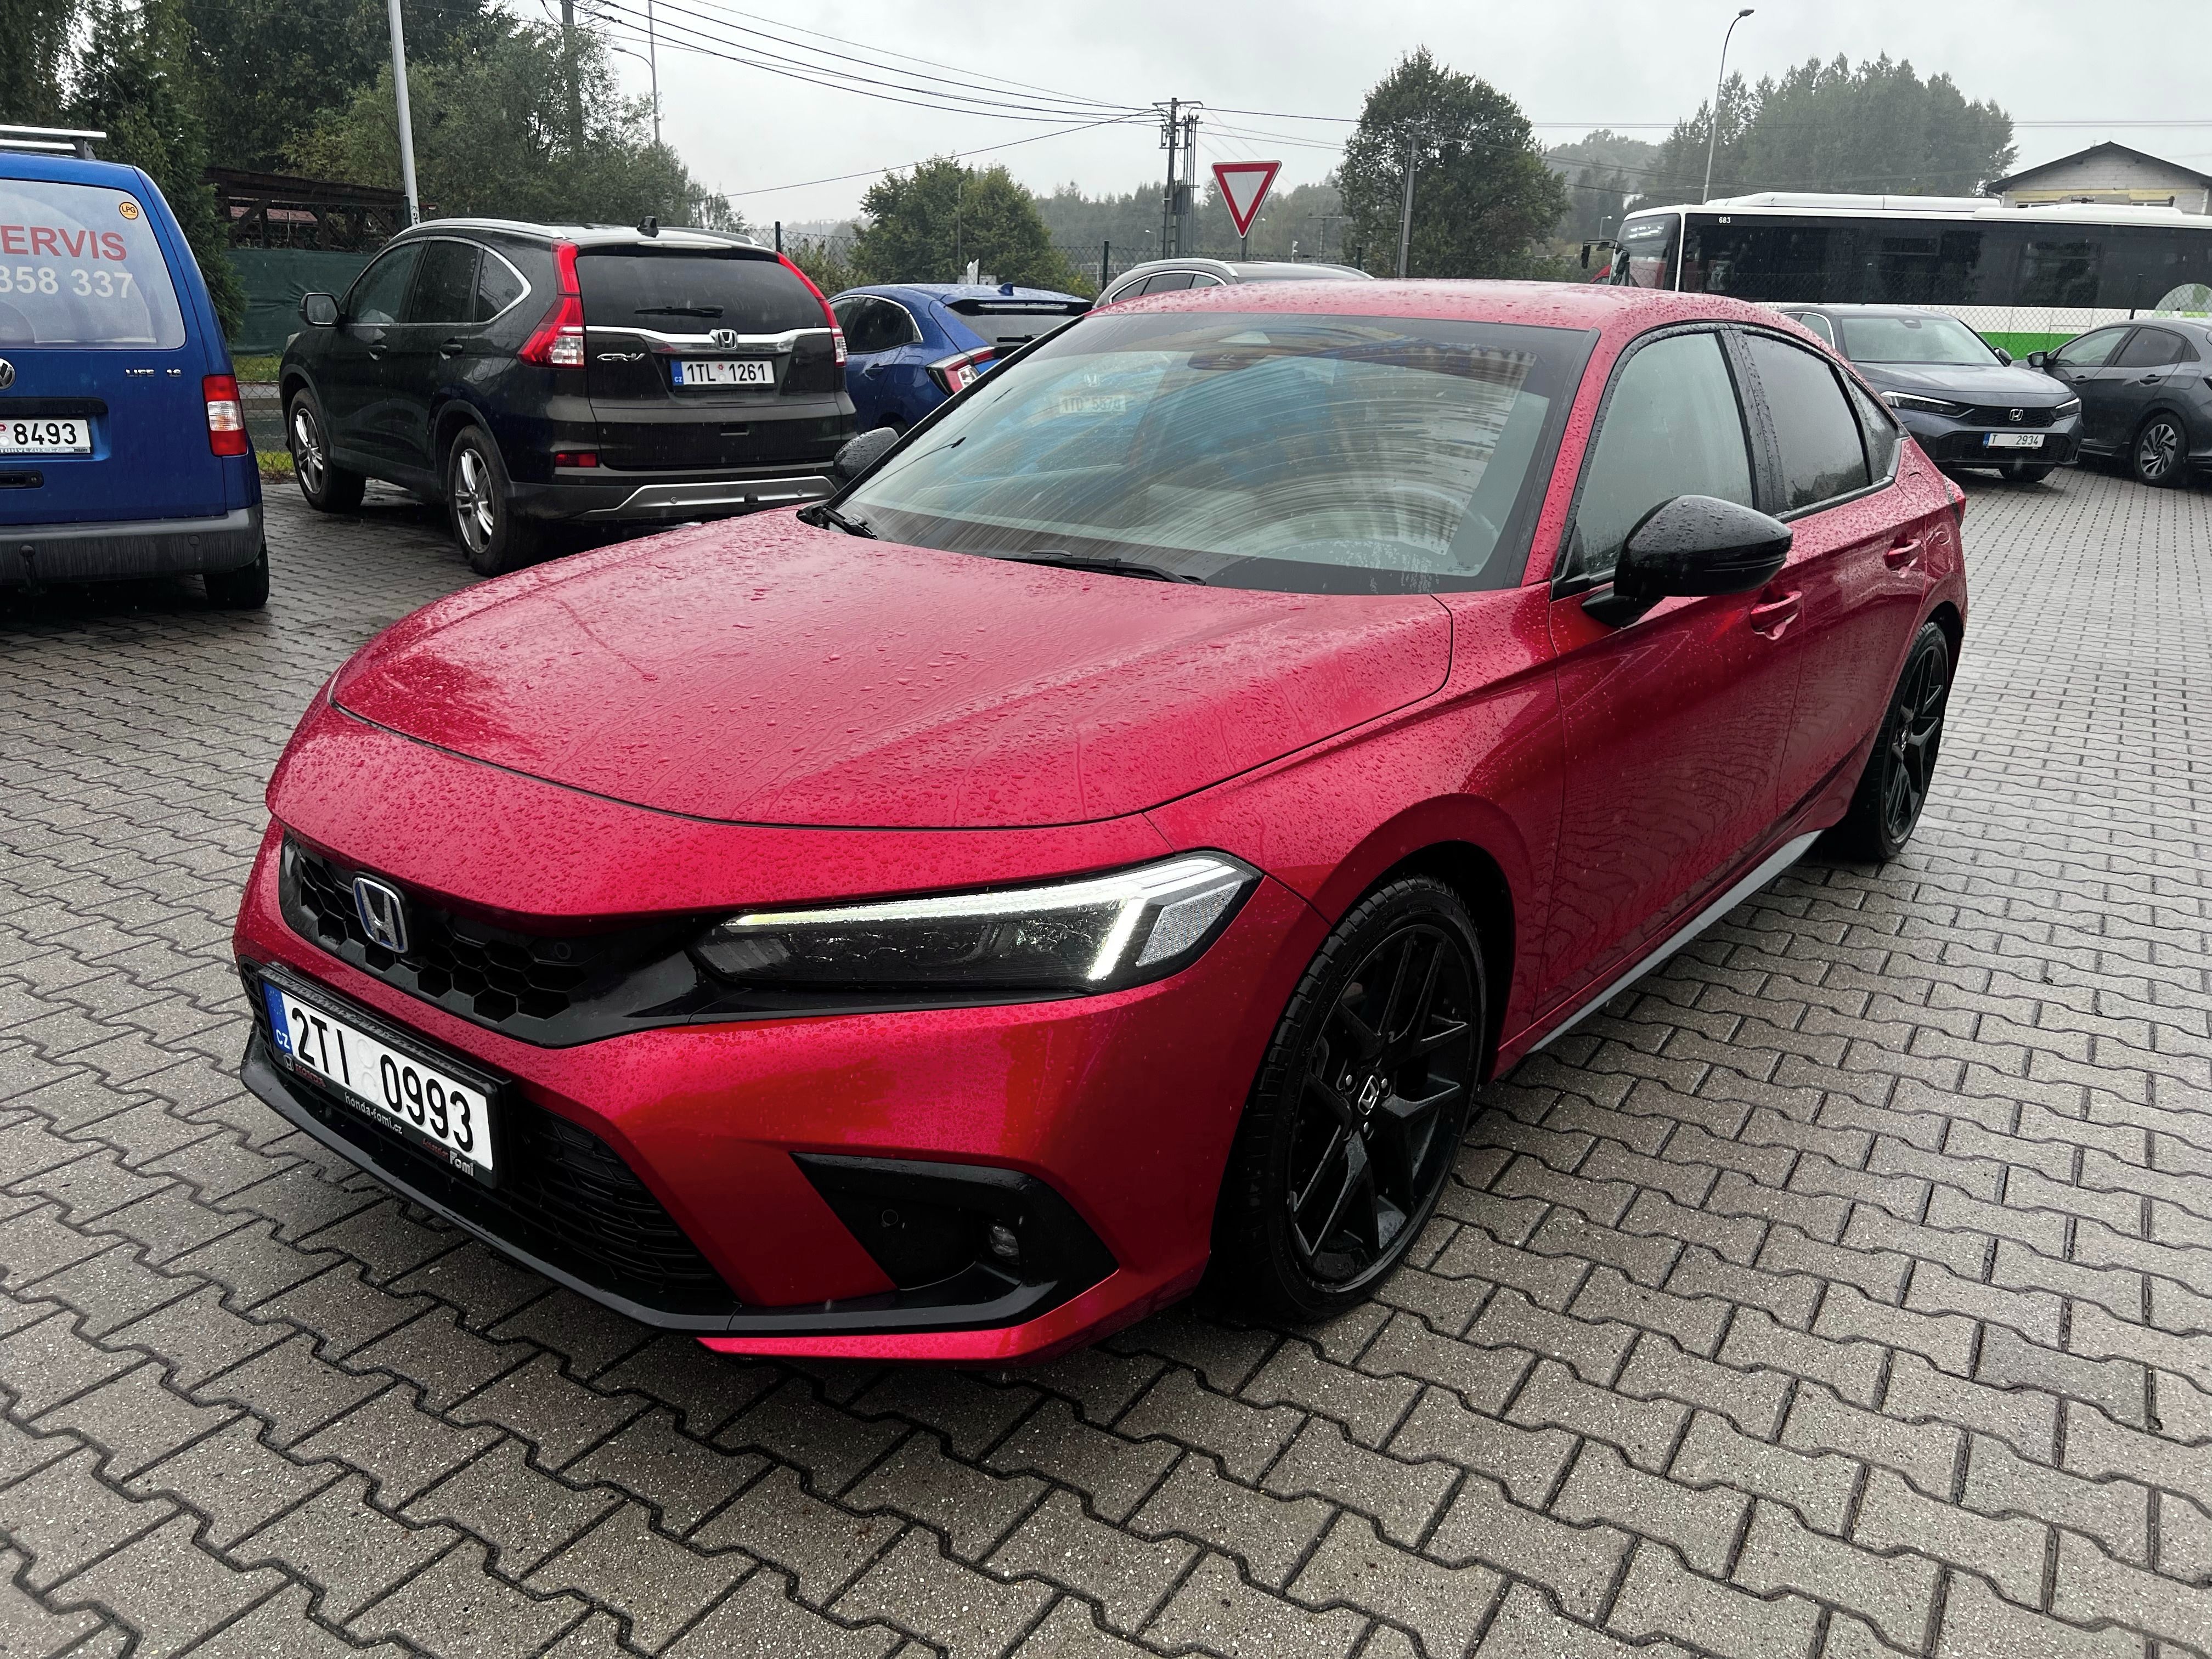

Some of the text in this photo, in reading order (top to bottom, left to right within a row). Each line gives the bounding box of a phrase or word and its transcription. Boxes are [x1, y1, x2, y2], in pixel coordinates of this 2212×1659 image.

[0, 225, 127, 261] ERVIS
[71, 269, 133, 298] 337
[125, 369, 155, 377] LIFE
[687, 363, 716, 382] 1TL
[729, 363, 765, 382] 1261
[13, 422, 77, 445] 8493
[1992, 434, 1998, 444] T
[2016, 435, 2039, 445] 2934
[275, 1007, 473, 1153] CZ 2TI 0993
[345, 1092, 403, 1135] honda-fomi.cz
[449, 1150, 473, 1177] Fomi
